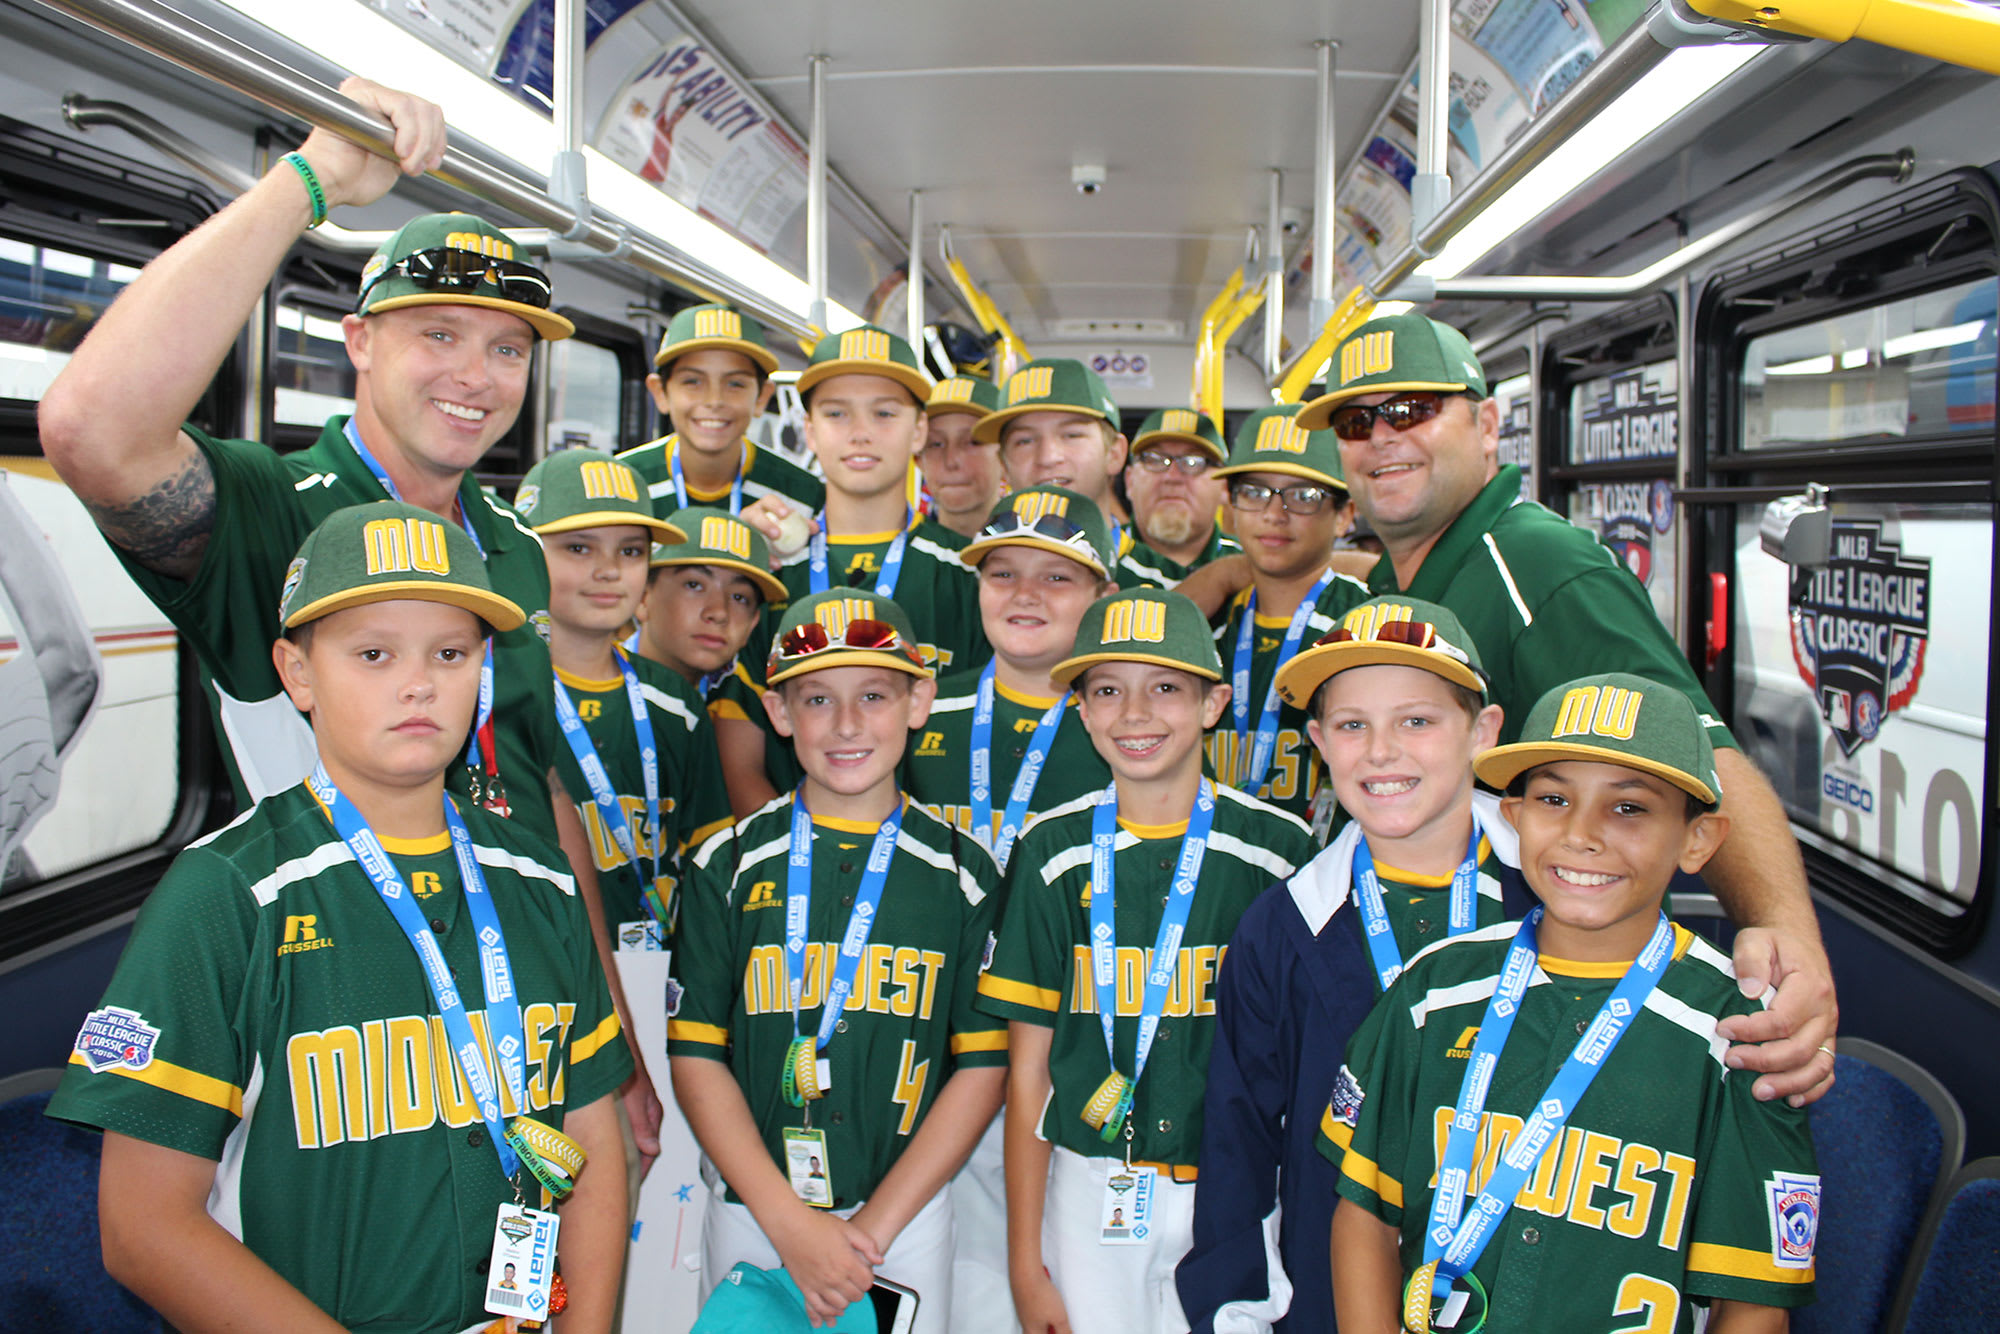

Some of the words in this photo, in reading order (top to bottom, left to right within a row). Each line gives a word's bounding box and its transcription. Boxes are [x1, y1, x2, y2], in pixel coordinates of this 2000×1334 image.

[695, 310, 741, 338] MW
[840, 330, 890, 361] MW
[1341, 331, 1394, 385] MW
[1255, 416, 1310, 454] MW
[1623, 410, 1678, 460] LEAGUE
[580, 461, 638, 502] MW
[1602, 482, 1653, 524] CLASSIC
[364, 518, 449, 576] MW
[701, 517, 750, 560] MW
[1837, 534, 1869, 561] MLB
[1847, 566, 1926, 620] LEAGUE
[1100, 599, 1166, 644] MW
[1817, 613, 1889, 667] CLASSIC
[1551, 685, 1644, 740] MW
[1823, 773, 1873, 814] GEICO
[277, 937, 335, 957] RUSSELL
[743, 941, 946, 1021] MDWEST
[90, 1035, 127, 1054] CLASSIC
[109, 1025, 152, 1048] LEAGUE
[286, 1002, 578, 1150] MIDWST
[891, 1039, 931, 1136] 4
[513, 1137, 539, 1168] WORLD
